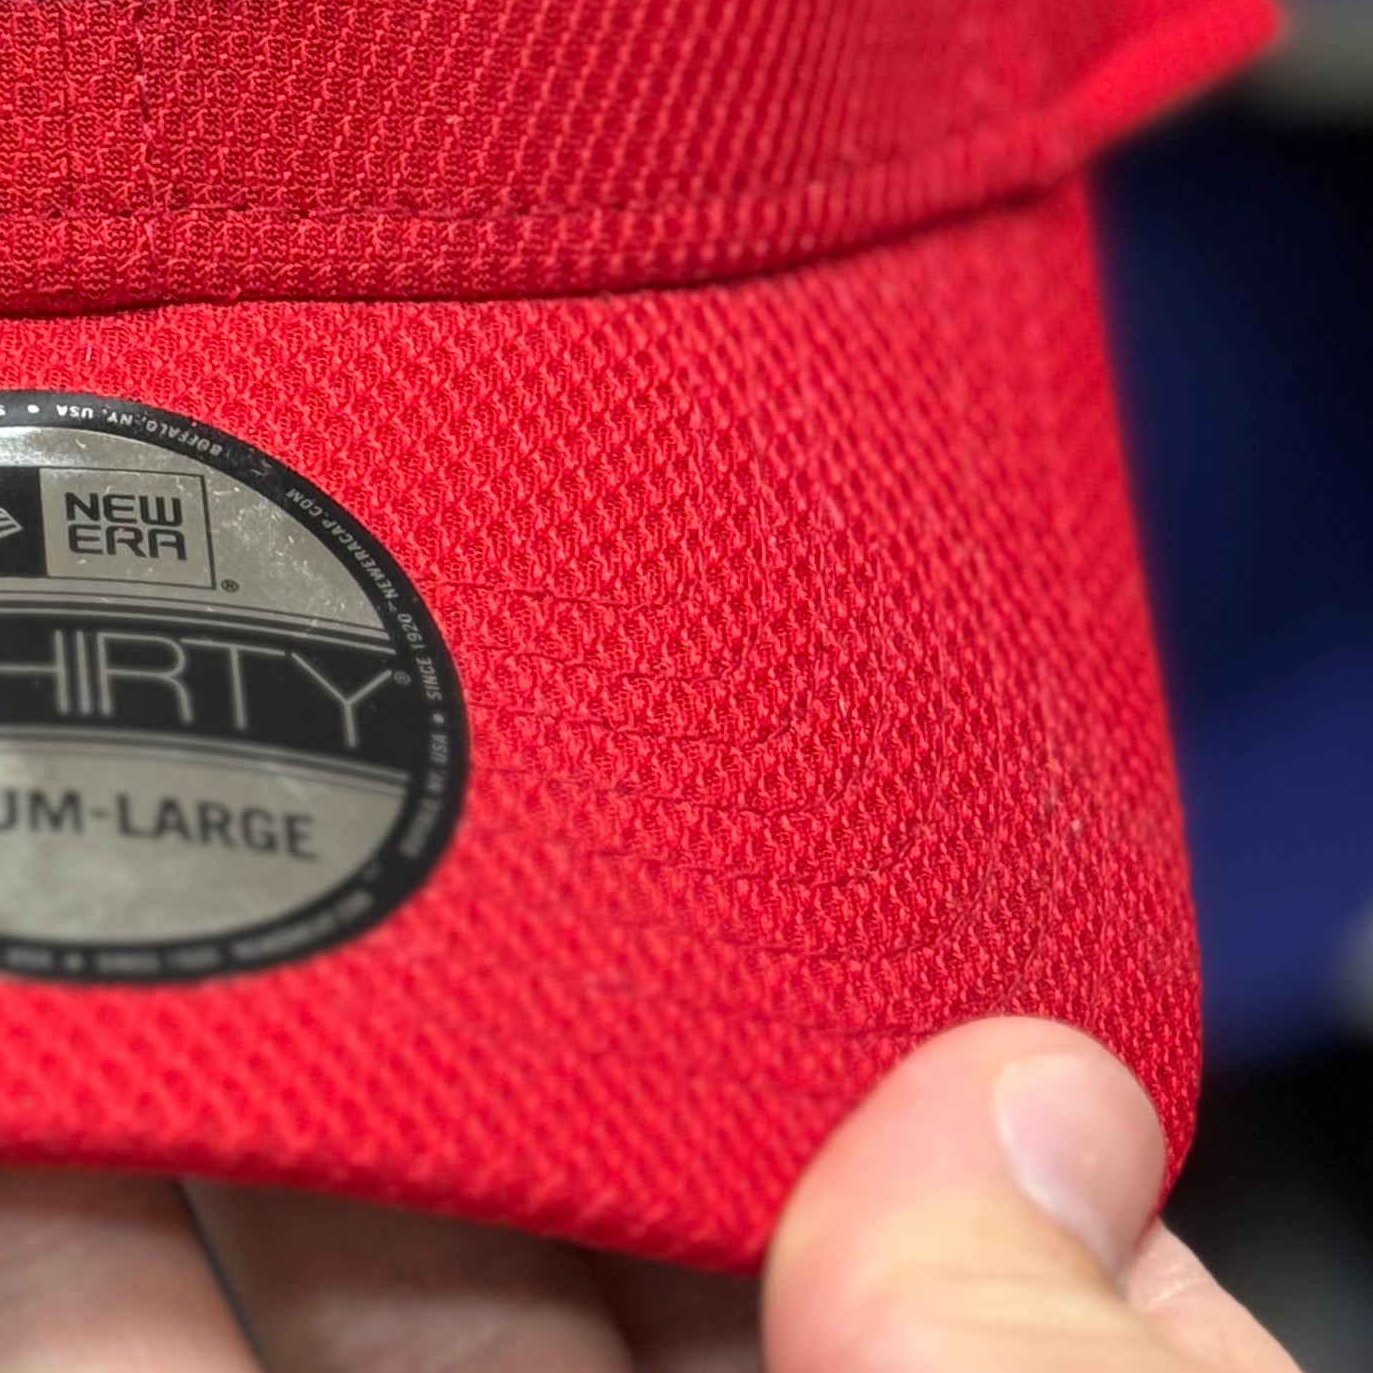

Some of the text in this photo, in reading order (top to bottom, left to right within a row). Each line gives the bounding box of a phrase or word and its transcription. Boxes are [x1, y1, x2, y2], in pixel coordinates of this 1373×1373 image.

[56, 404, 94, 419] USA
[64, 492, 183, 527] NEW
[67, 524, 188, 561] ERA
[285, 488, 400, 600] NEWERACAP.COM
[397, 613, 427, 650] 1920
[417, 657, 442, 701] SINCE
